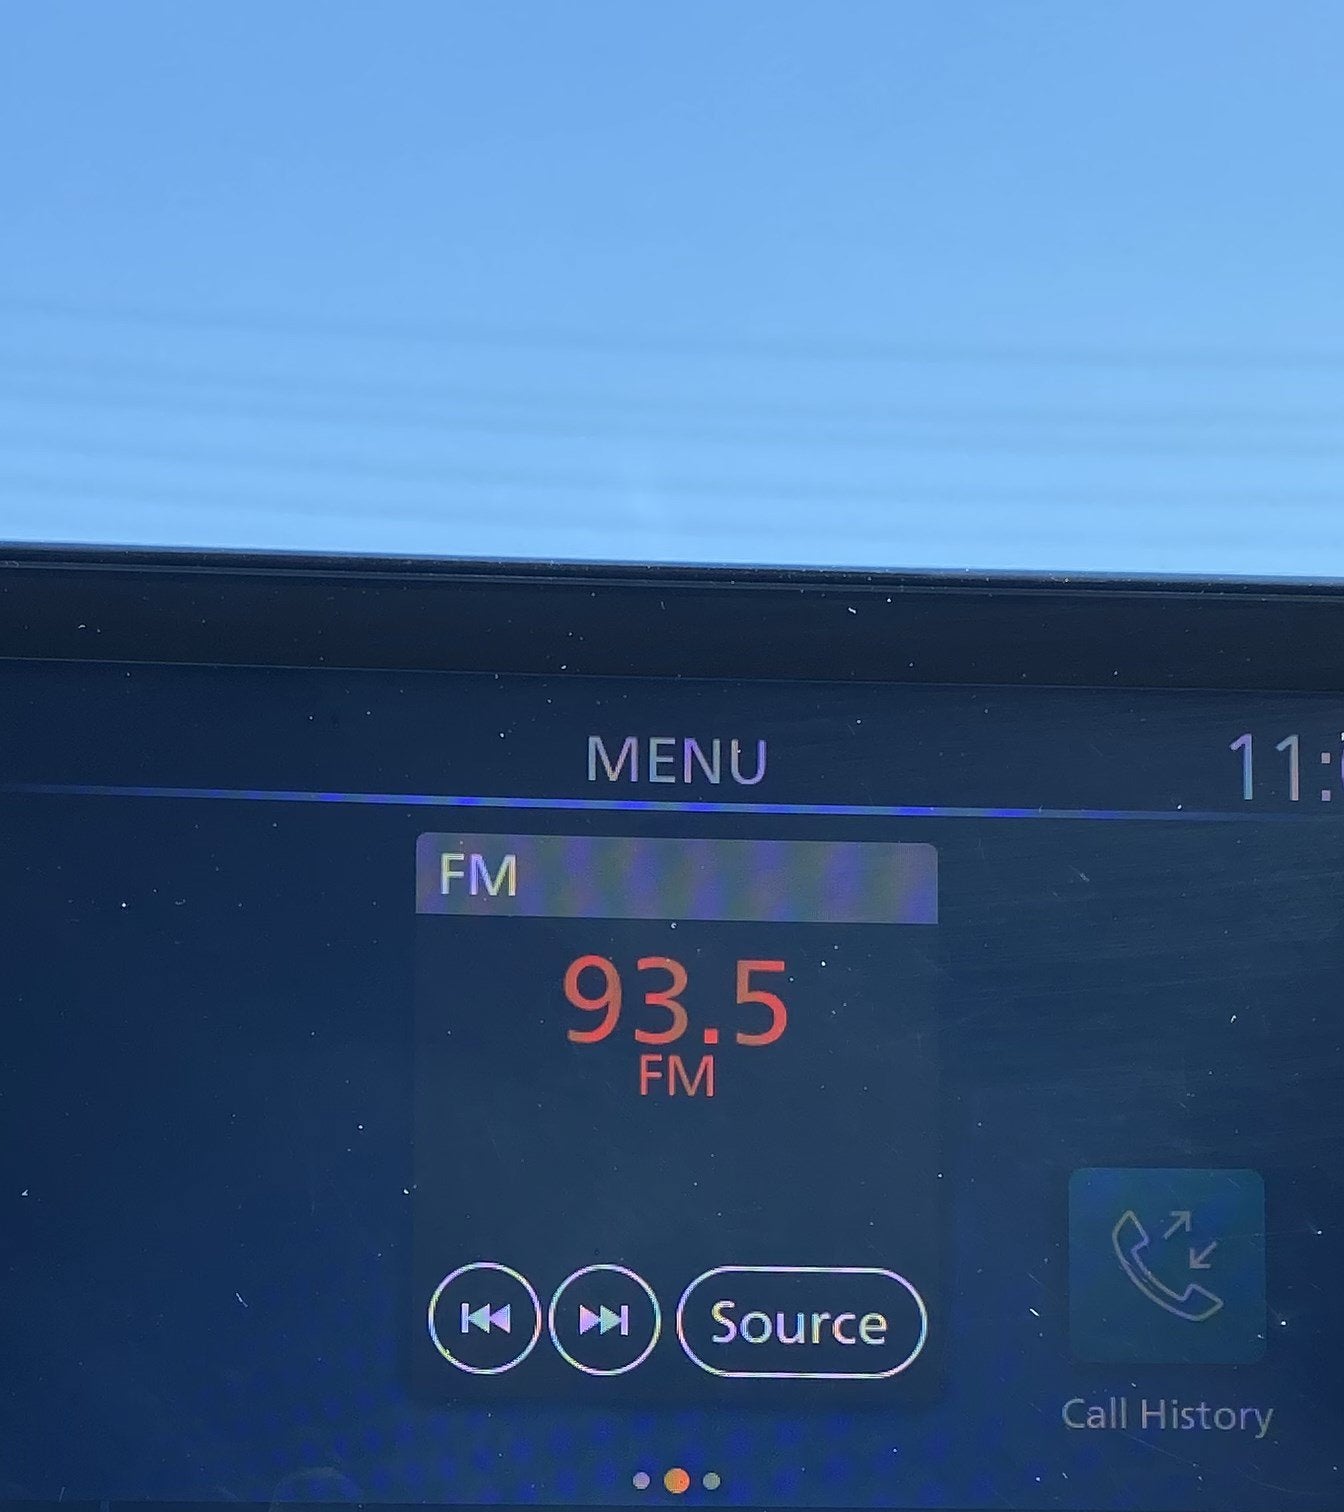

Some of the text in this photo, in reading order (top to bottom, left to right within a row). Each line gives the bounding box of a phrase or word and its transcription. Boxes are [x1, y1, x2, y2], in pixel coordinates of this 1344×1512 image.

[587, 736, 768, 786] MENU
[440, 852, 518, 897] FM
[563, 954, 789, 1046] 93.5
[639, 1053, 715, 1098] FM
[710, 1300, 888, 1346] Source
[1061, 1396, 1274, 1439] Call History
